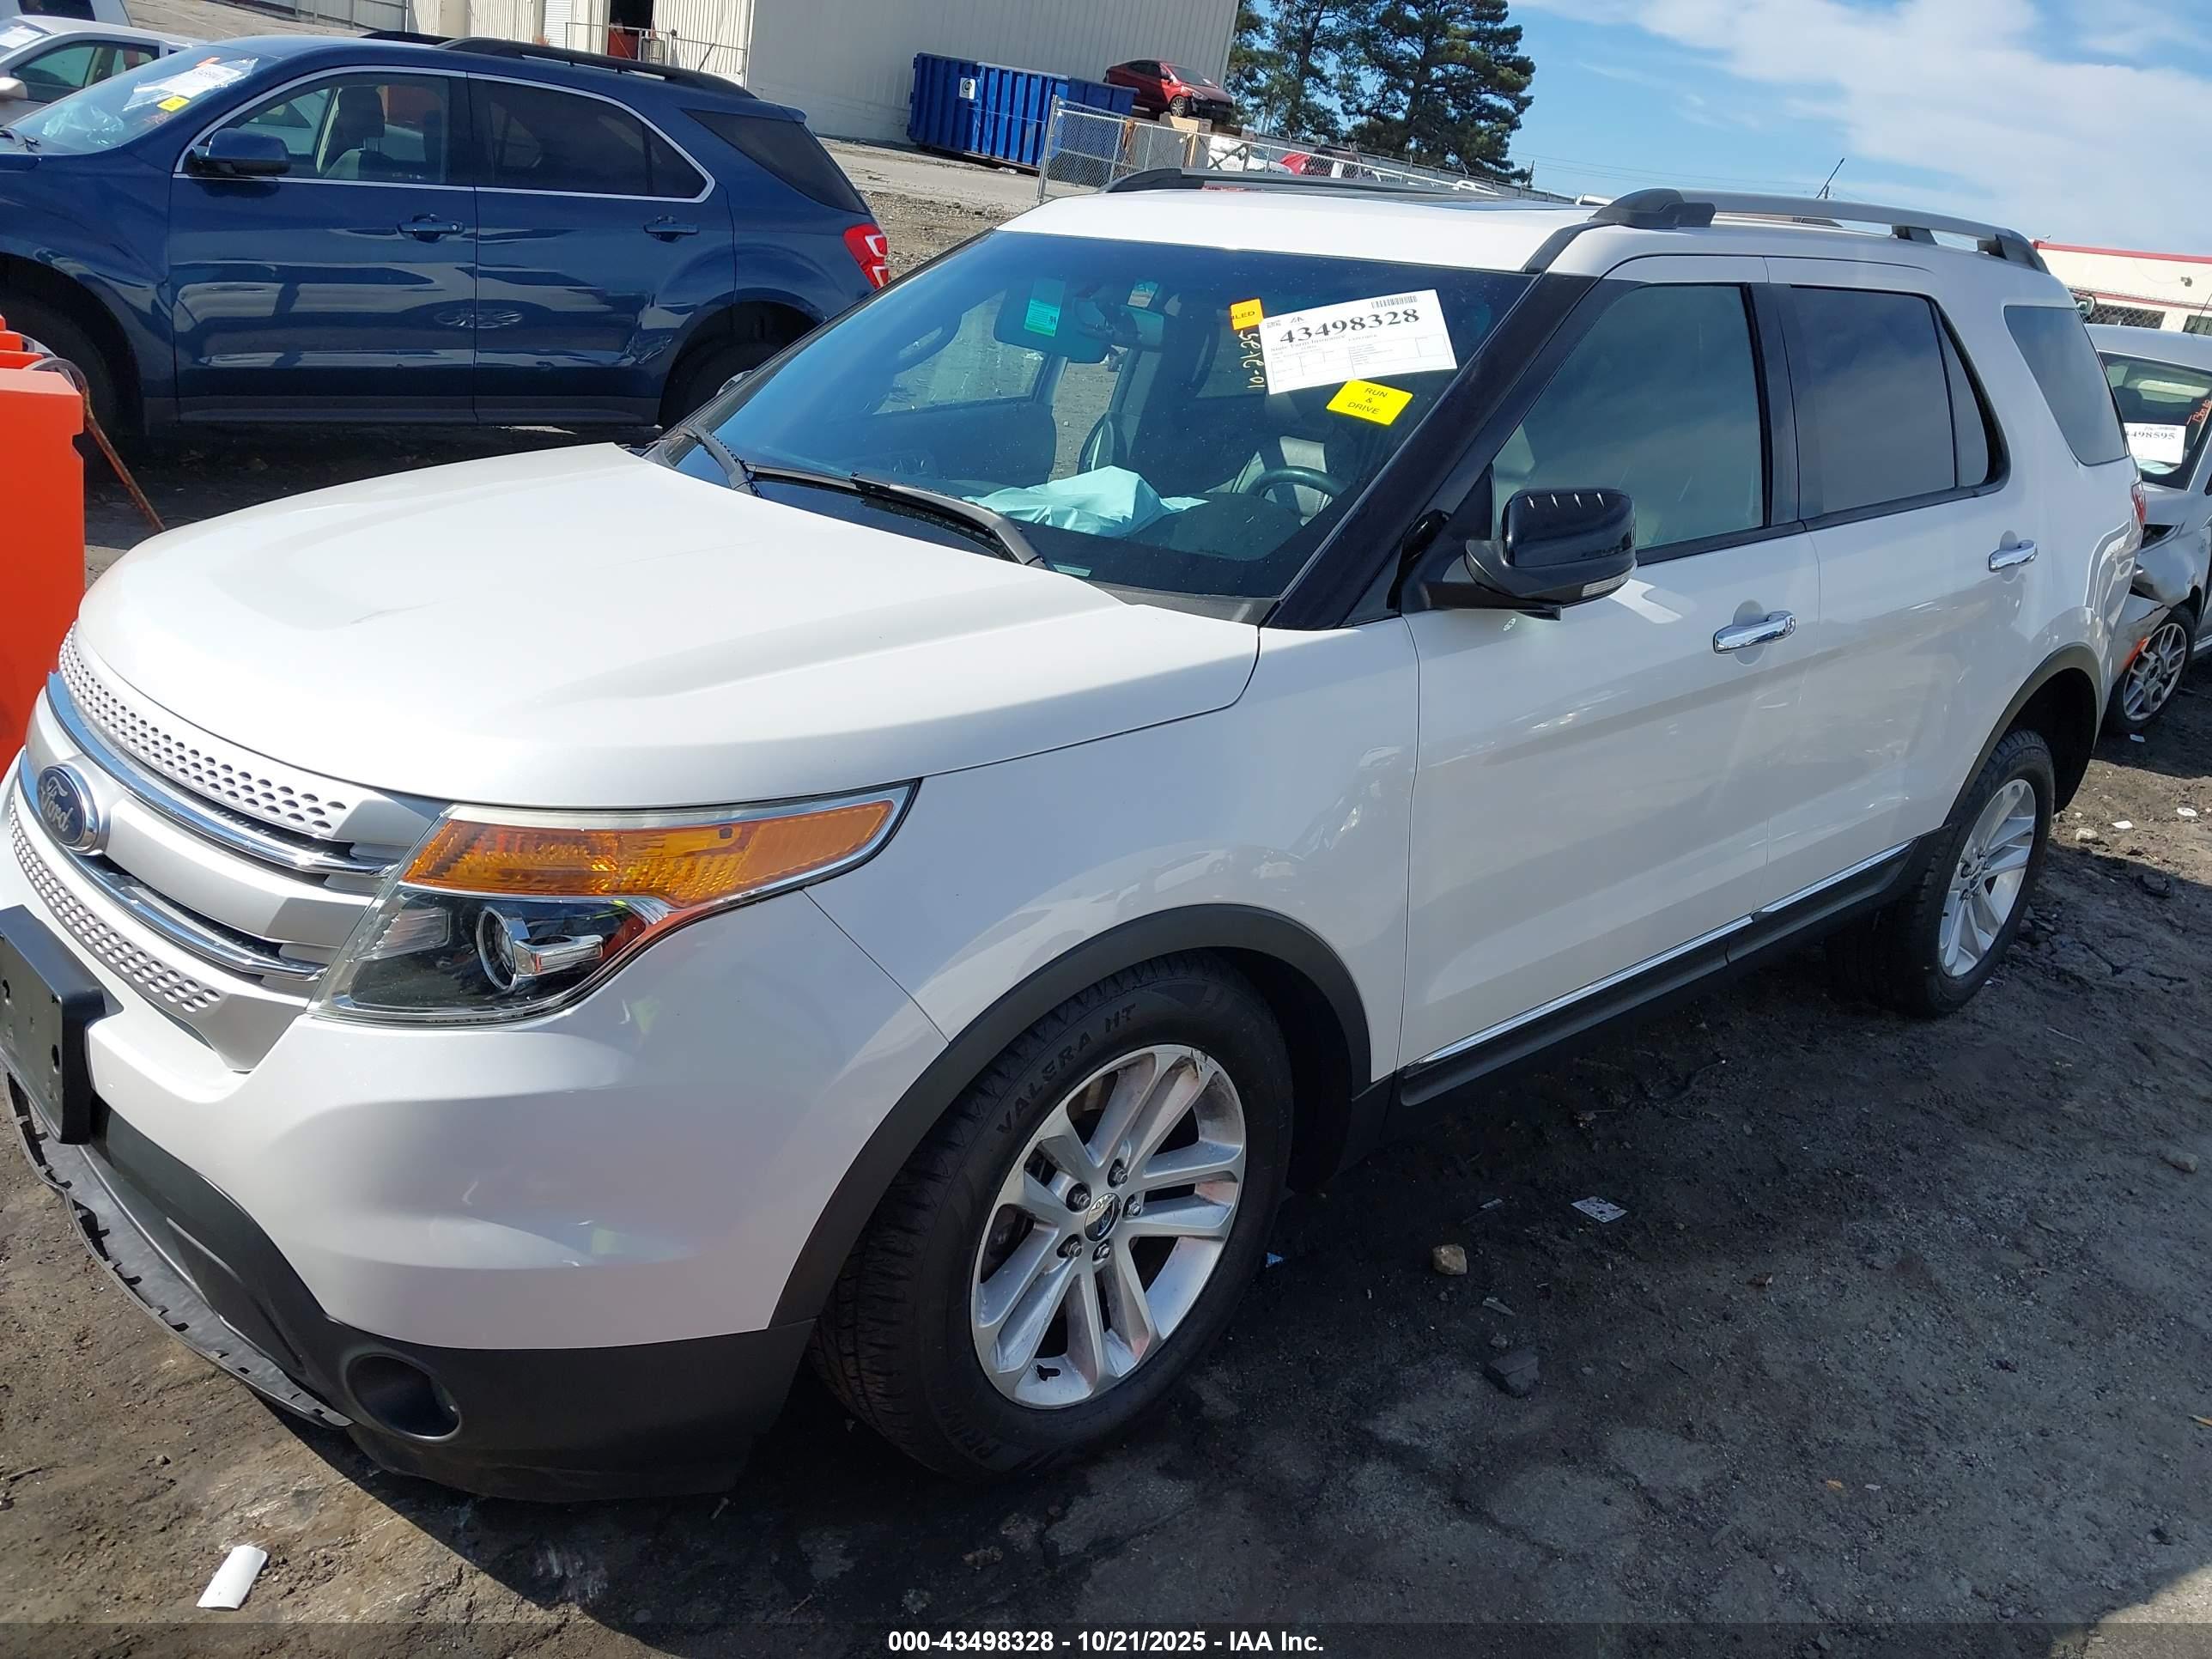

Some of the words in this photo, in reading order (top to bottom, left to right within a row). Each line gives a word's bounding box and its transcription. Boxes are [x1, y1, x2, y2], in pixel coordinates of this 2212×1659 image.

[1279, 308, 1420, 343] 43498328
[1347, 401, 1380, 415] DRIVE
[1364, 387, 1388, 398] RUN
[42, 776, 74, 832] Ford
[996, 1031, 1091, 1134] VALERA
[1104, 1003, 1137, 1032] HT
